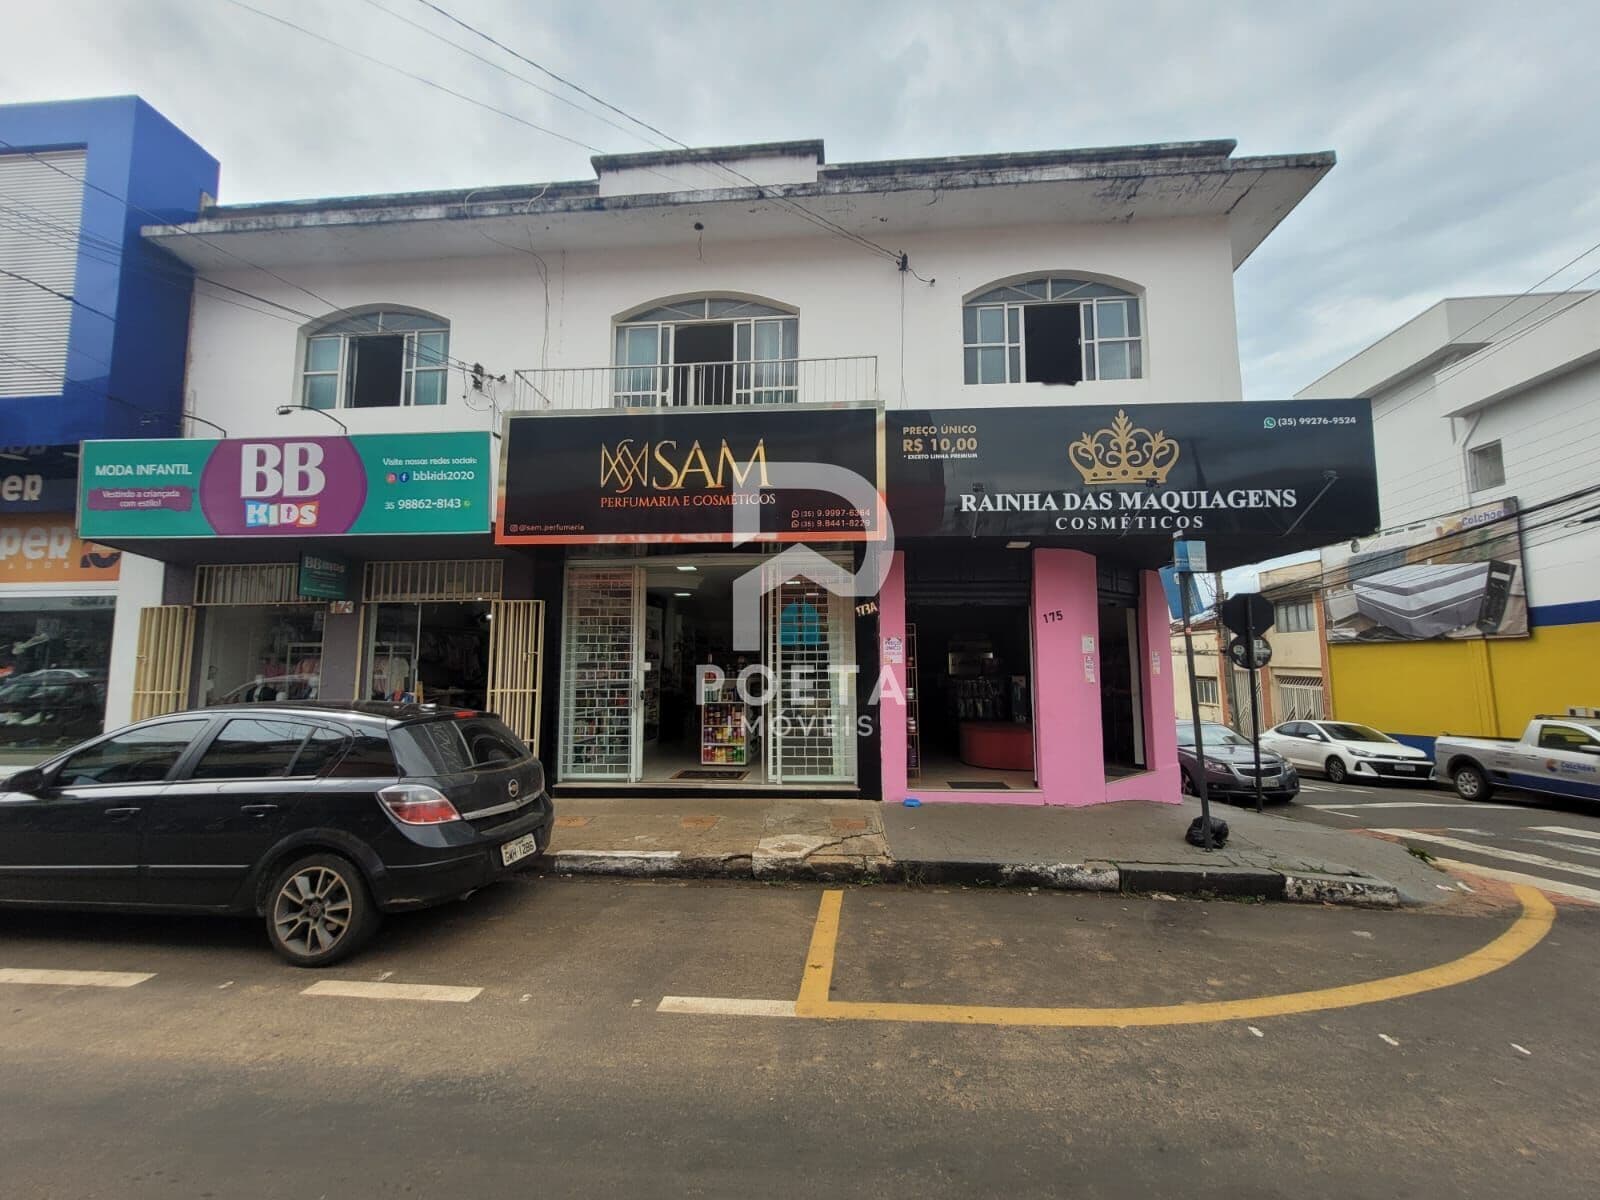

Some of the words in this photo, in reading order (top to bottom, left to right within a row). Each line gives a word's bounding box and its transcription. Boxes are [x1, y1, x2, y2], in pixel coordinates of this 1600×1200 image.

[1278, 417, 1297, 427] (35)
[902, 426, 938, 437] PREÇO
[940, 423, 977, 434] ÚNICO
[902, 438, 924, 453] R$
[930, 437, 978, 453] 10,00
[382, 457, 404, 466] Visite
[429, 457, 451, 465] redes
[652, 438, 774, 491] SAM
[95, 464, 134, 476] MODA
[136, 463, 193, 476] INFANTIL
[240, 442, 326, 499] BB
[412, 470, 476, 481] bbkids2020
[384, 501, 396, 511] 35
[397, 498, 463, 511] 98862-8143
[600, 496, 682, 508] PERFUMARIA
[683, 495, 692, 506] E
[693, 493, 777, 507] COSMÉTICOS
[959, 493, 1059, 512] RAINHA
[1062, 492, 1113, 511] DAS
[1118, 489, 1298, 513] MAQUIAGENS
[1055, 512, 1204, 530] COSMÉTICOS
[329, 601, 354, 614] 173
[1043, 610, 1064, 624] 175
